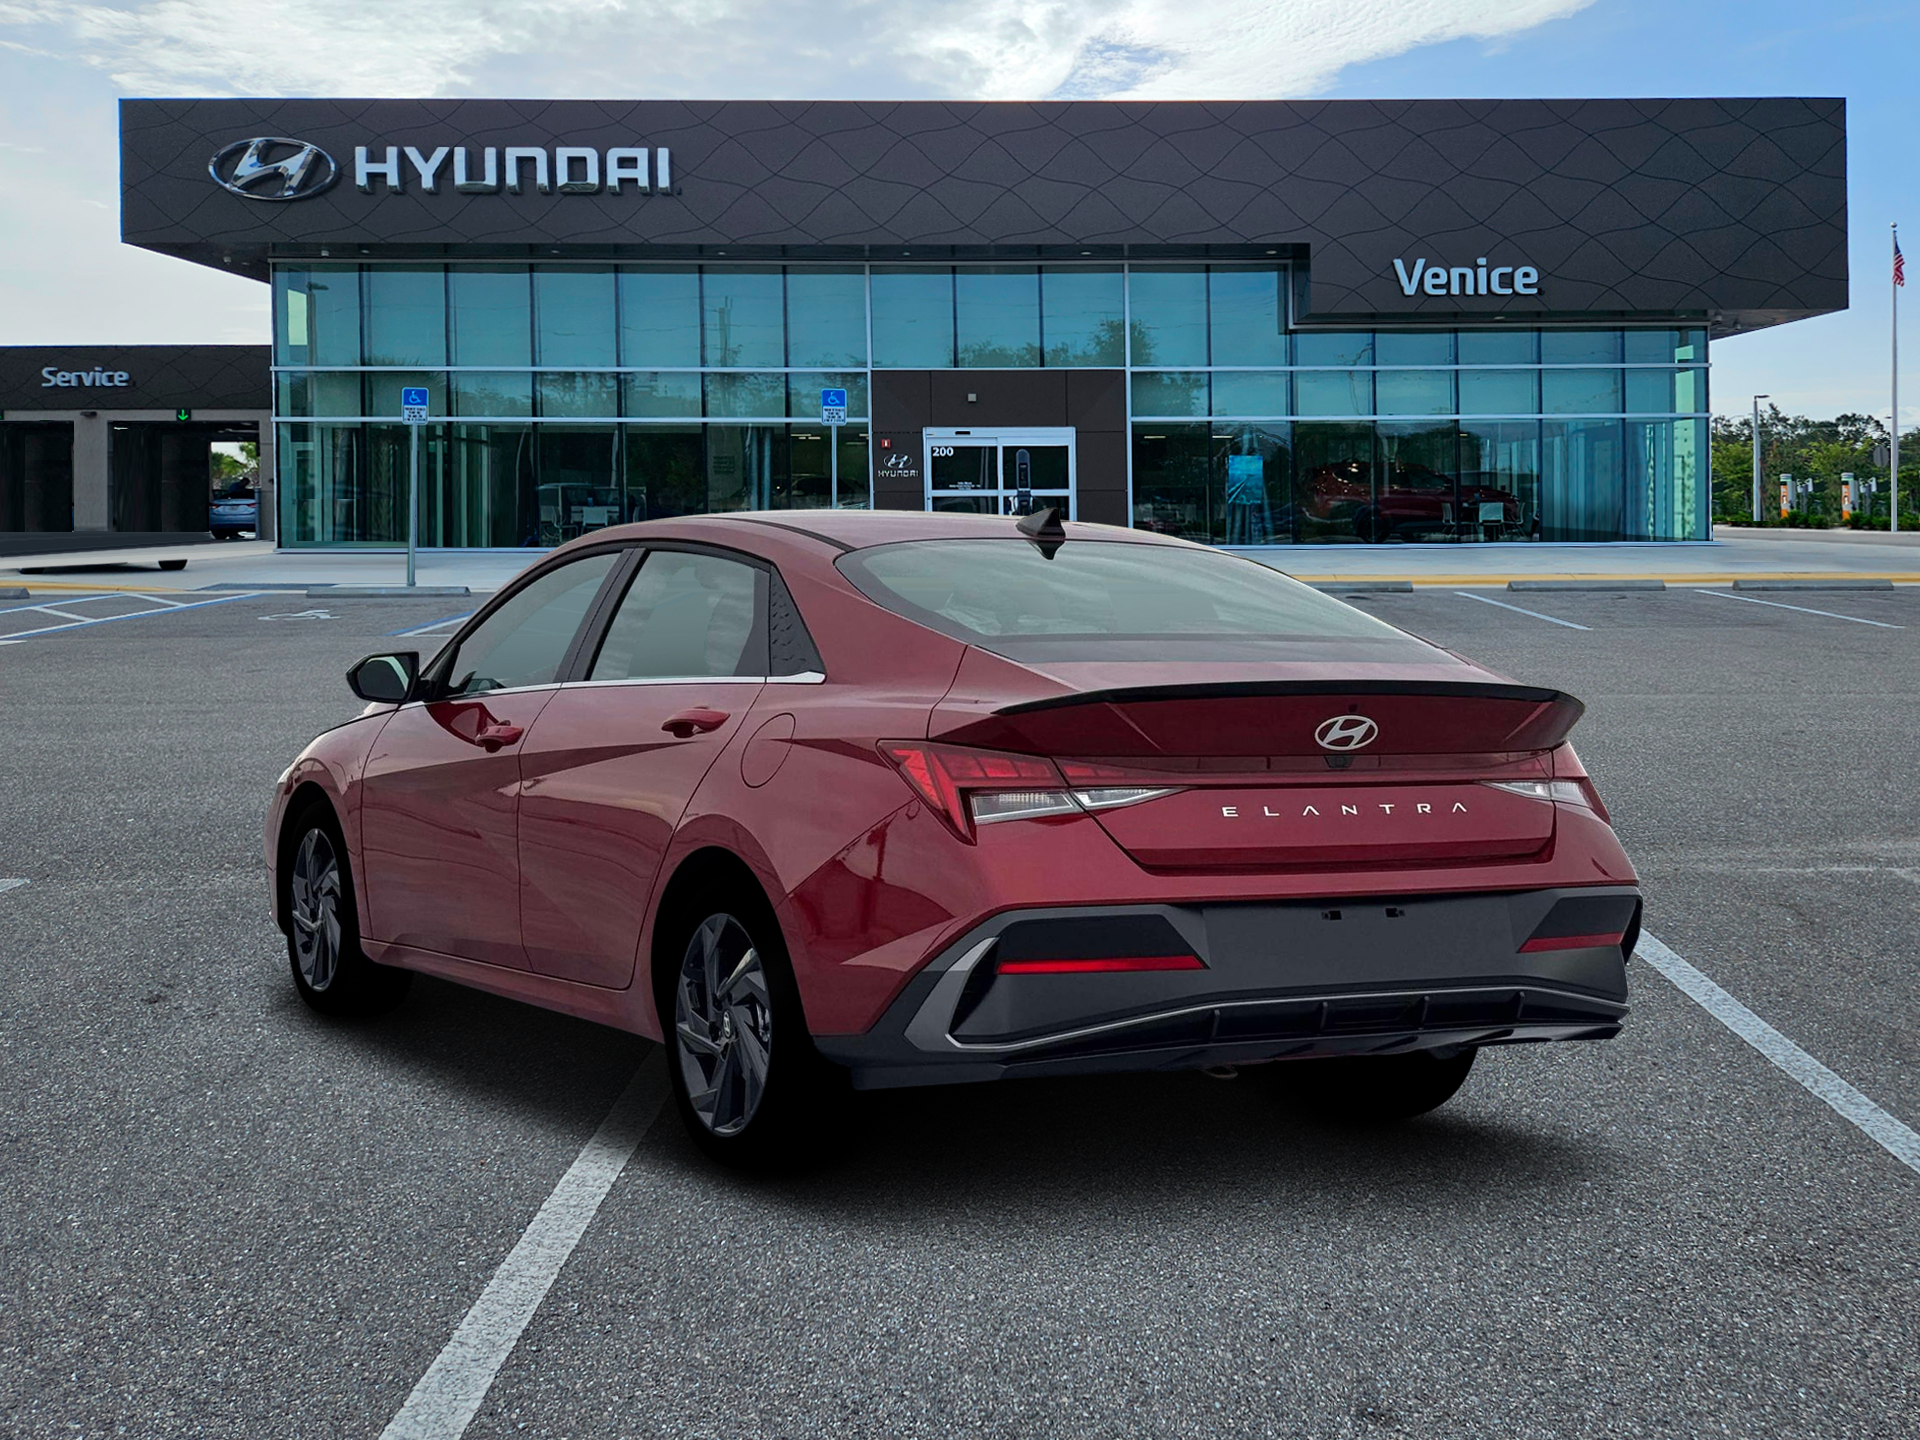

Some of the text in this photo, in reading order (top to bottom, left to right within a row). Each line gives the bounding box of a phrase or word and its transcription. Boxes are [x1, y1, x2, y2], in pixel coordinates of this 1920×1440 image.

[354, 146, 671, 194] HYUNDAI
[1393, 256, 1539, 296] Venice
[41, 366, 130, 387] Service
[932, 446, 955, 458] 200
[877, 469, 919, 478] HYUNDAI
[1221, 802, 1468, 818] ELANTRA
